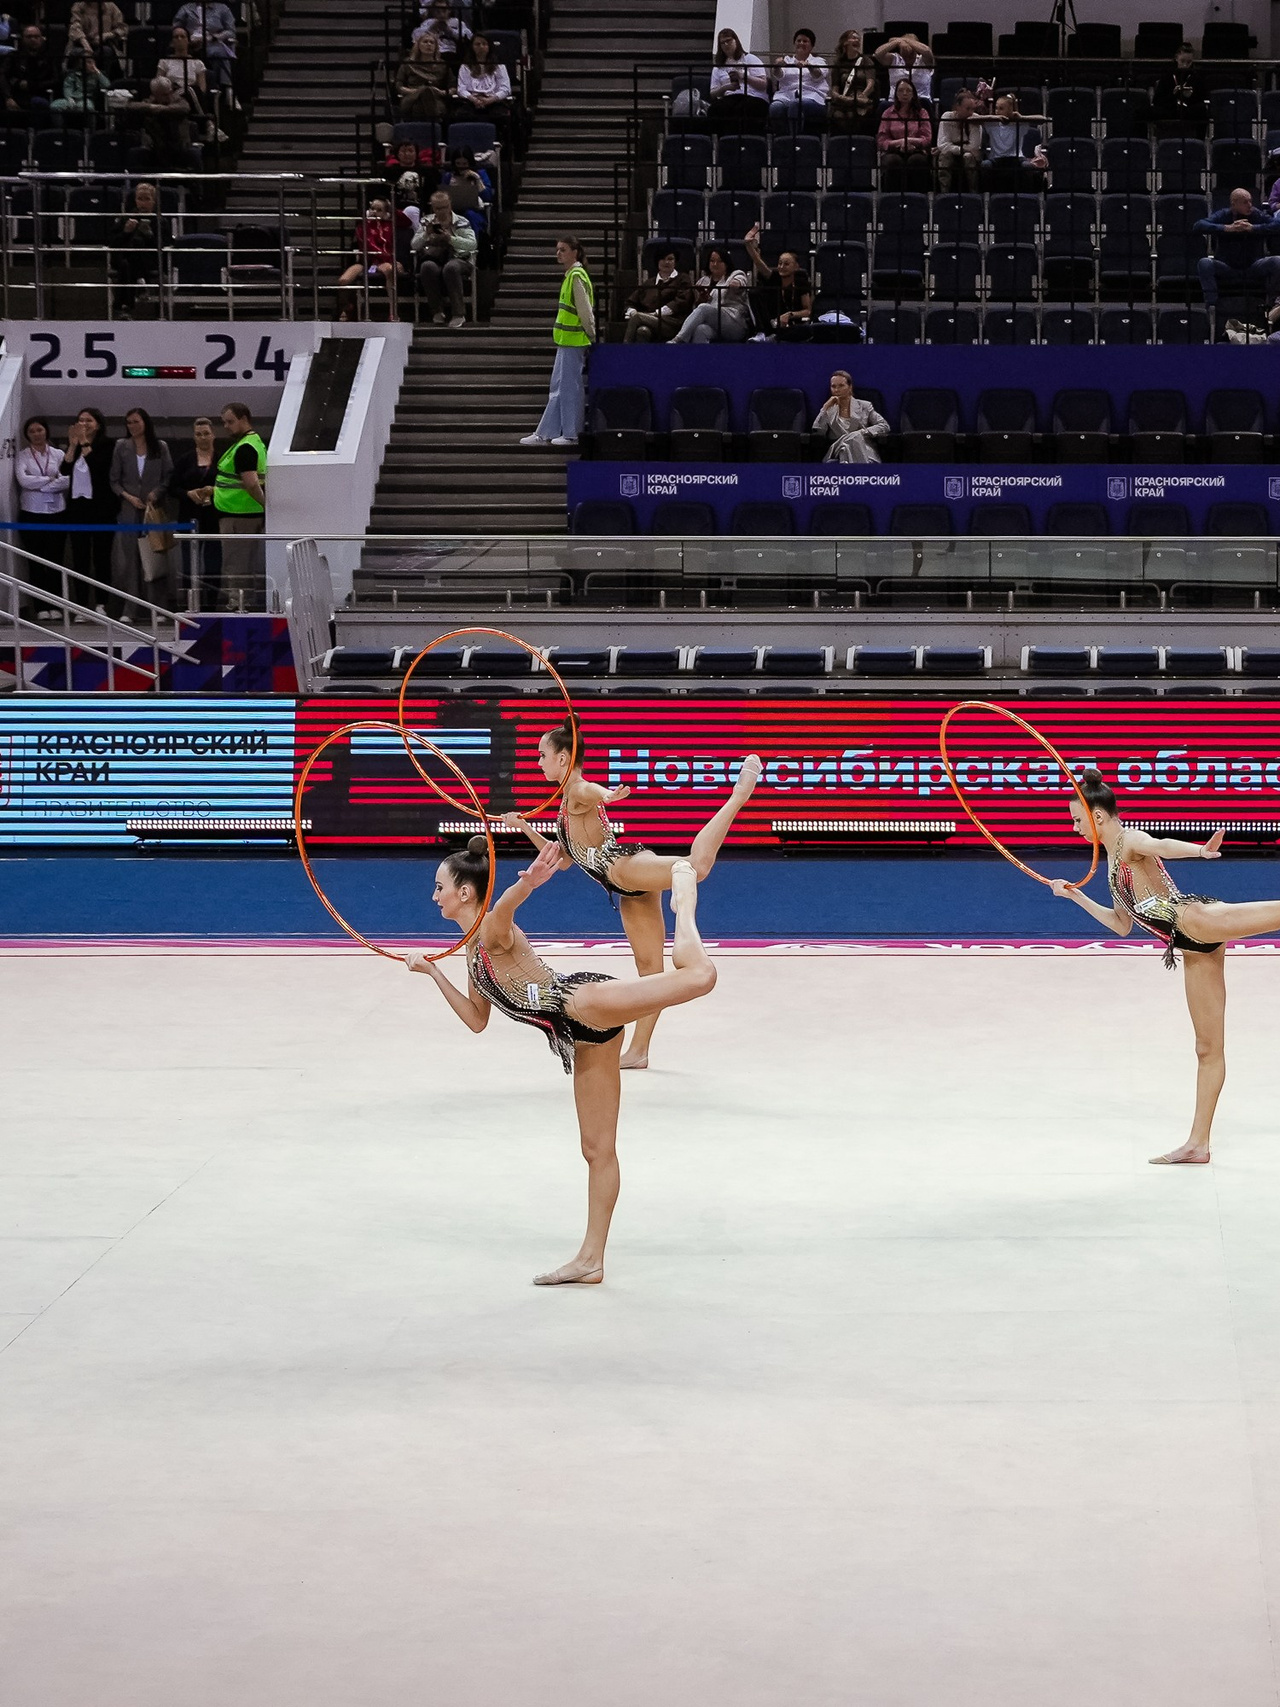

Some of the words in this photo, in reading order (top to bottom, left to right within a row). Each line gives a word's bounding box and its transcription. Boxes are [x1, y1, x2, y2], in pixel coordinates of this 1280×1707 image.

[29, 332, 118, 379] 2.5
[204, 334, 290, 382] 2.4
[647, 473, 738, 485] КРАСНОЯРСКИЙ
[809, 474, 901, 486] КРАСНОЯРСКИЙ
[971, 475, 1062, 487] КРАСНОЯРСКИЙ
[1134, 475, 1225, 487] КРАСНОЯРСКИЙ
[647, 484, 677, 495] КРАЙ
[809, 485, 840, 496] КРАЙ
[971, 486, 1001, 497] КРАЙ
[1134, 486, 1164, 497] КРАЙ
[36, 730, 268, 755] КРАСНОЯРСКИЙ
